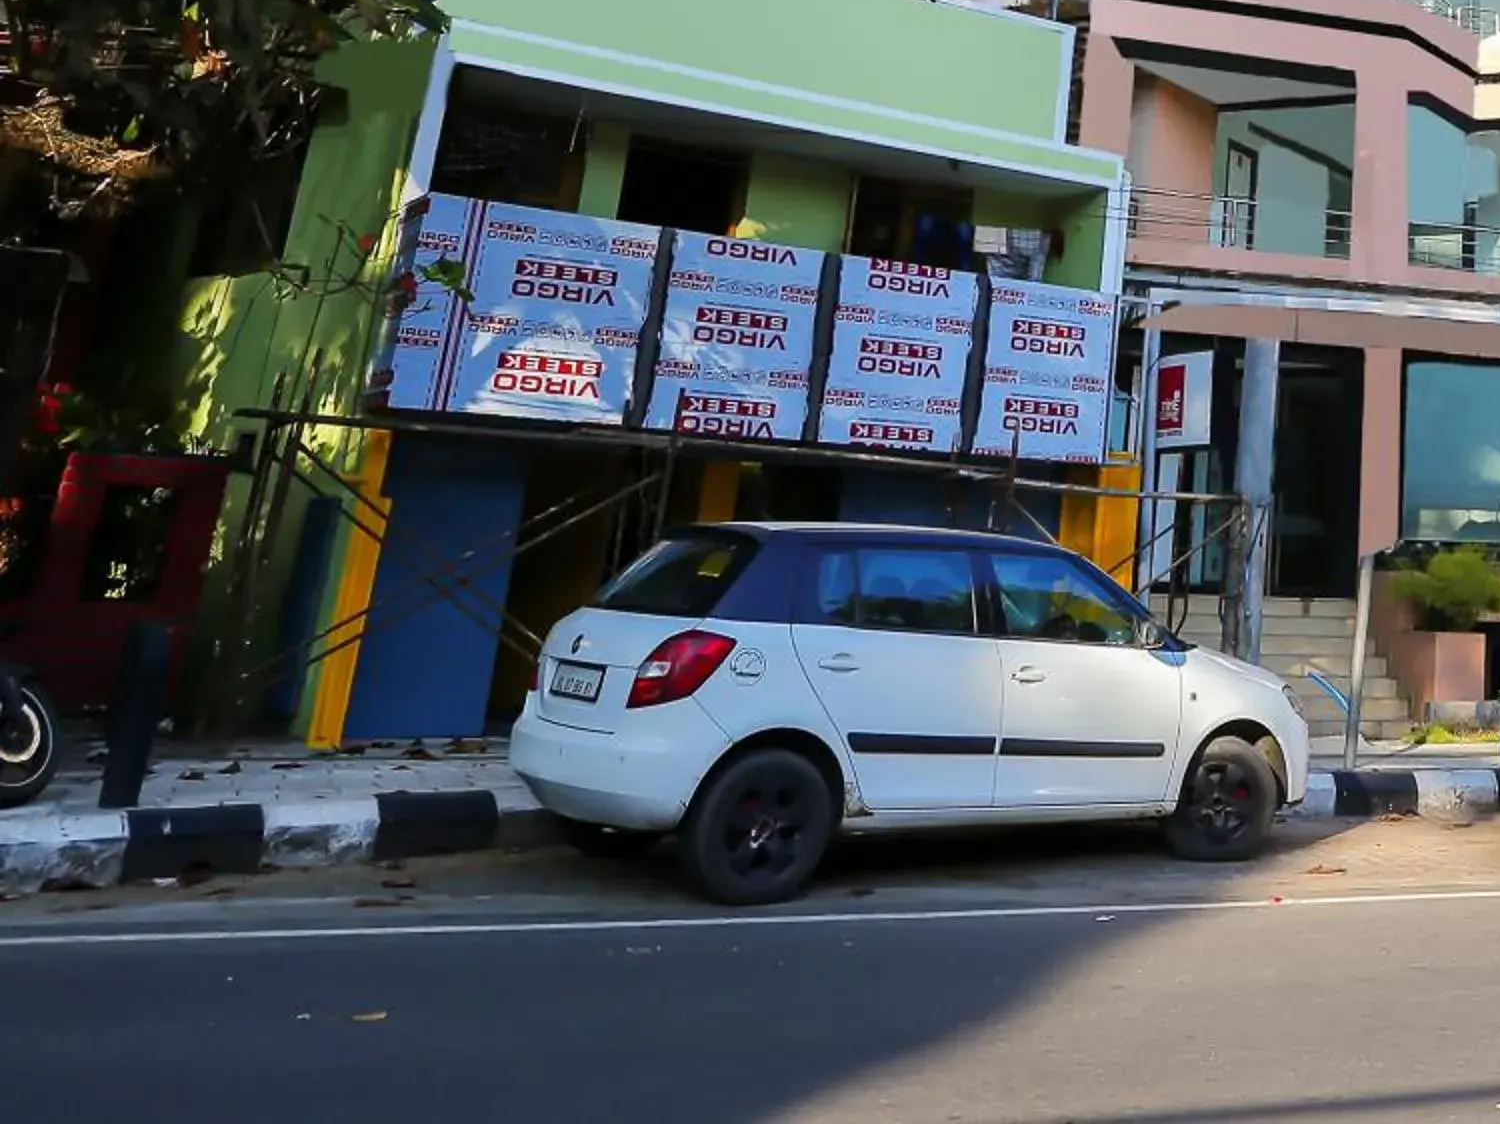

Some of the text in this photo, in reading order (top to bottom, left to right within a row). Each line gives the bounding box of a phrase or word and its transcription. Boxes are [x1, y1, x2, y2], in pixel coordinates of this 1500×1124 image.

[707, 239, 797, 266] VIRGO
[521, 261, 615, 285] SLEEK
[512, 279, 615, 306] VIRGO
[868, 273, 949, 298] VIRGO
[703, 308, 786, 330] SLEEK
[1015, 320, 1083, 339] SLEEK
[693, 326, 786, 351] VIRGO
[864, 339, 940, 360] SLEEK
[1011, 336, 1084, 358] VIRGO
[504, 355, 600, 376] SLEEK
[858, 356, 940, 379] VIRGO
[493, 373, 599, 398] VIRGO
[687, 396, 773, 417] SLEEK
[1008, 398, 1076, 417] SLEEK
[680, 415, 773, 439] VIRGO
[853, 423, 931, 442] SLEEK
[1003, 415, 1077, 435] VIRGO
